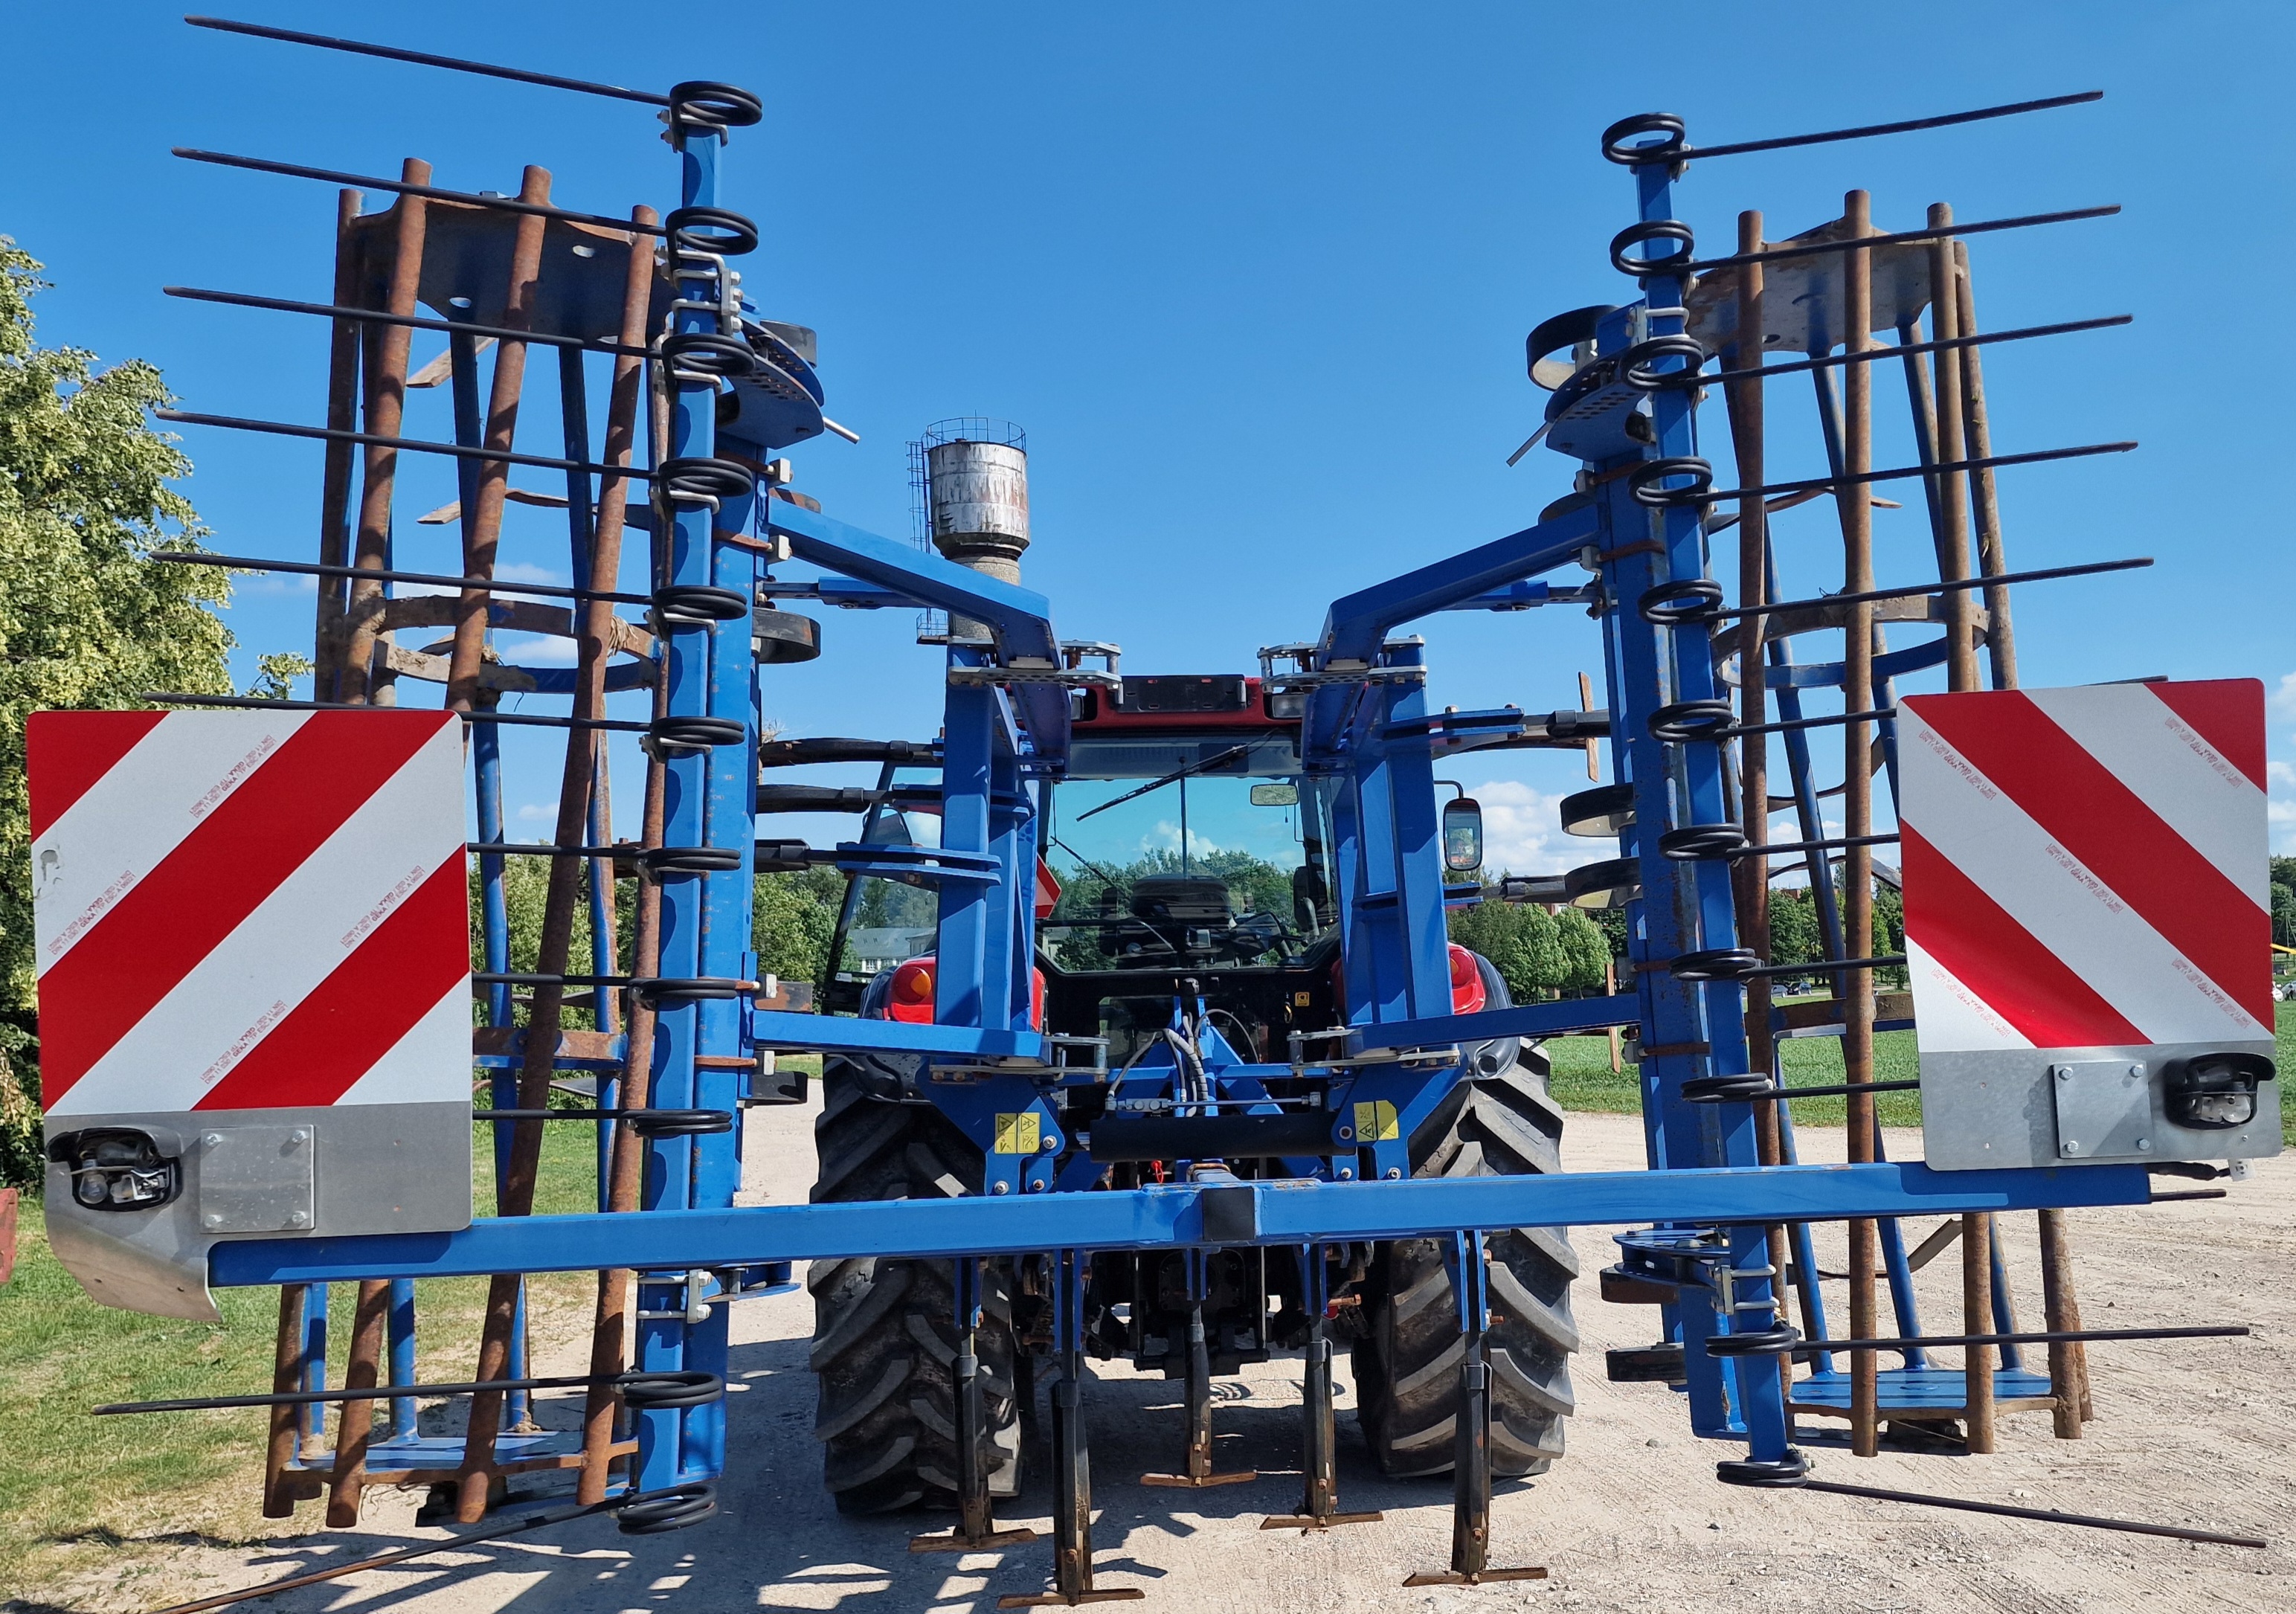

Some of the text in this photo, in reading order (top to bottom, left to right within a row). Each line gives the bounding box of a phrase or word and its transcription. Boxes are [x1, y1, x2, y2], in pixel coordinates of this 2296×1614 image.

[229, 761, 245, 777] GEKA
[1944, 756, 1958, 769] GEKA
[1958, 761, 1972, 774] GEKA
[222, 777, 238, 791] GEKA
[87, 897, 103, 913] GEKA
[379, 892, 394, 907] GEKA
[80, 913, 96, 927] GEKA
[372, 907, 388, 922] GEKA
[239, 1026, 255, 1042] GEKA
[233, 1042, 248, 1057] GEKA
